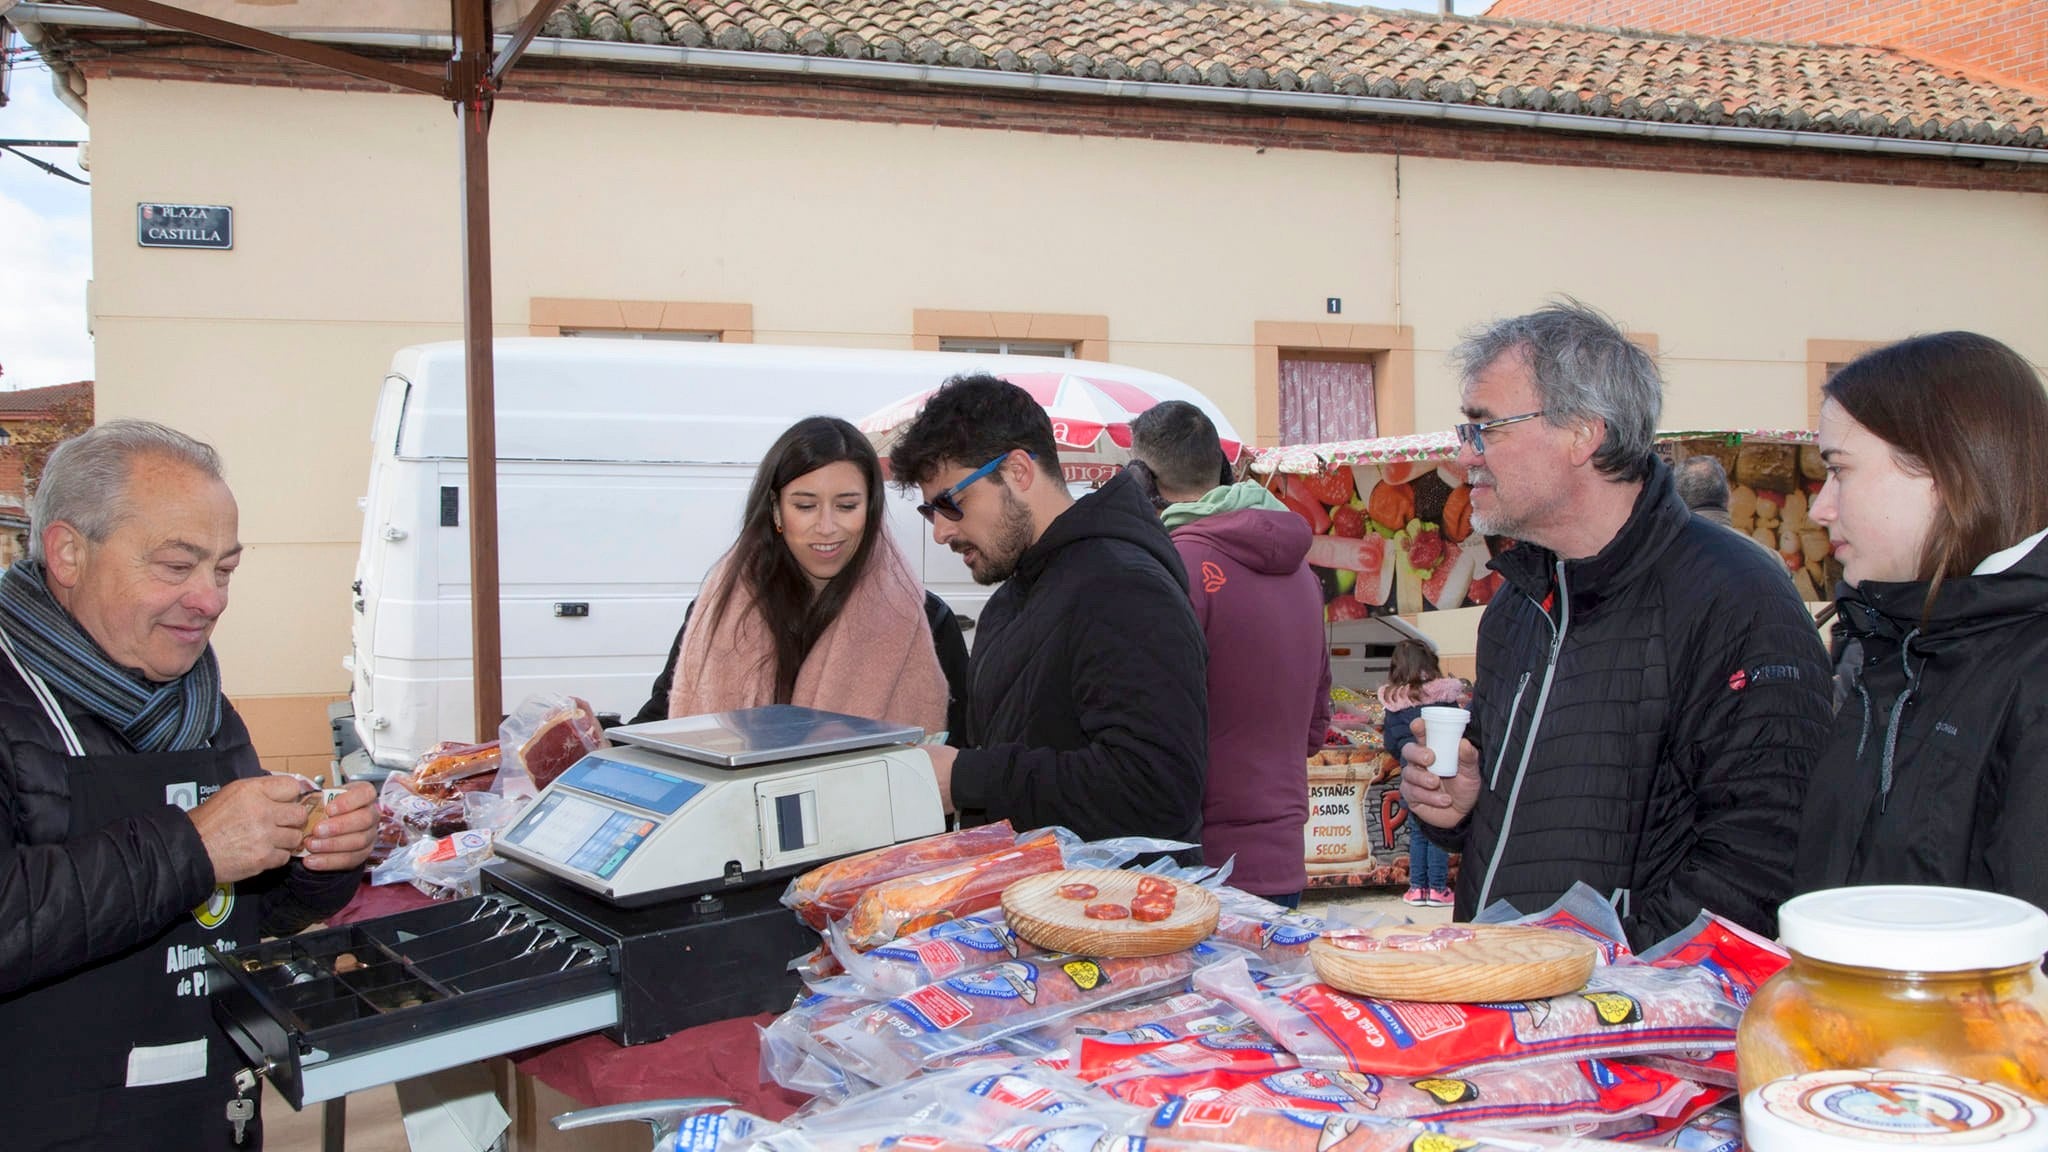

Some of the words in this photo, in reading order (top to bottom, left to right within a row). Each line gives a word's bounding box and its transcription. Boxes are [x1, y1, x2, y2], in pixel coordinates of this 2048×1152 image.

[162, 207, 208, 219] PLAZA
[148, 228, 221, 241] CASTILLA
[1331, 299, 1336, 312] 1
[1308, 784, 1355, 798] ASTAÑAS
[1312, 804, 1350, 816] ASADAS
[1313, 825, 1352, 837] FRUTOS
[1316, 843, 1347, 855] SECOS
[177, 977, 192, 996] de
[1357, 1016, 1386, 1048] Casa
